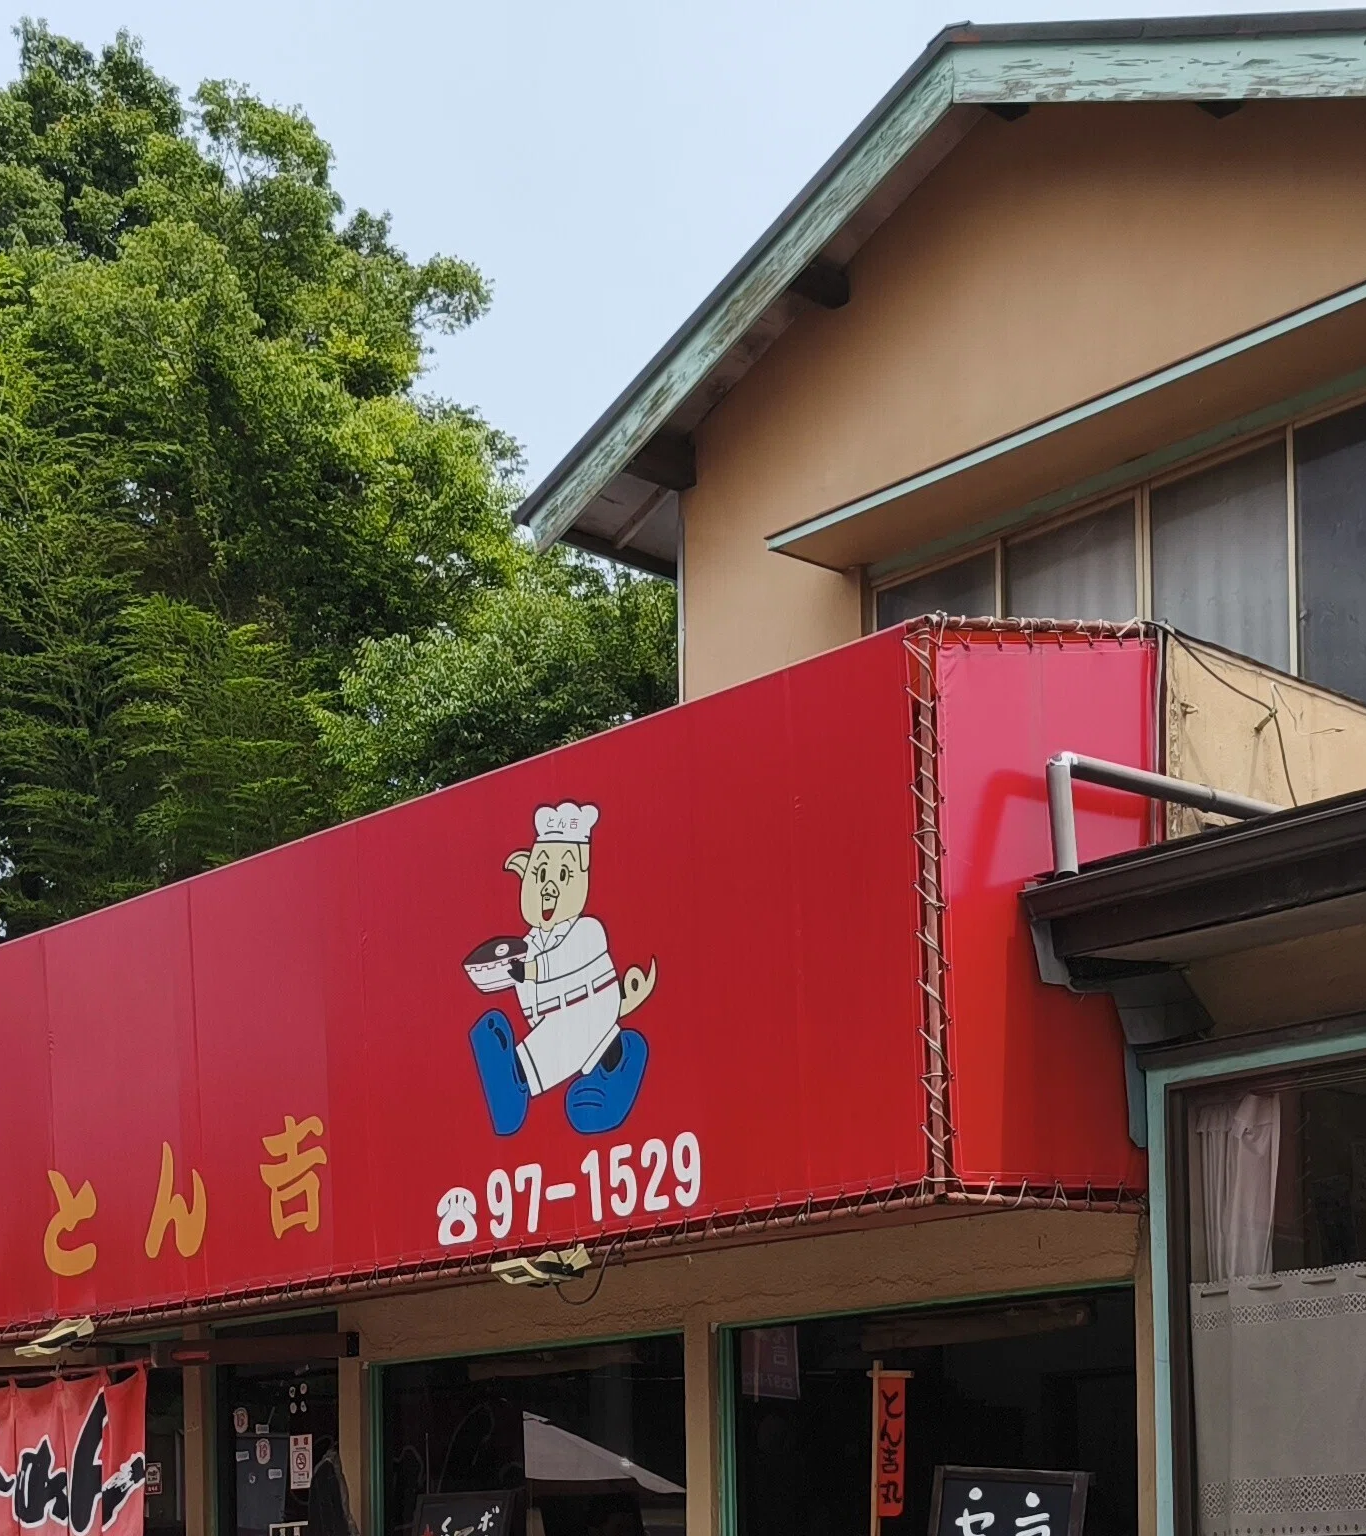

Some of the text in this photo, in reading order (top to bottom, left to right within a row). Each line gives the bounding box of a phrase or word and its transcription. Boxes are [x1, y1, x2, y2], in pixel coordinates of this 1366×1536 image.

[546, 816, 579, 831] とん吉
[42, 1114, 329, 1278] とん吉
[486, 1131, 701, 1239] 97-1529
